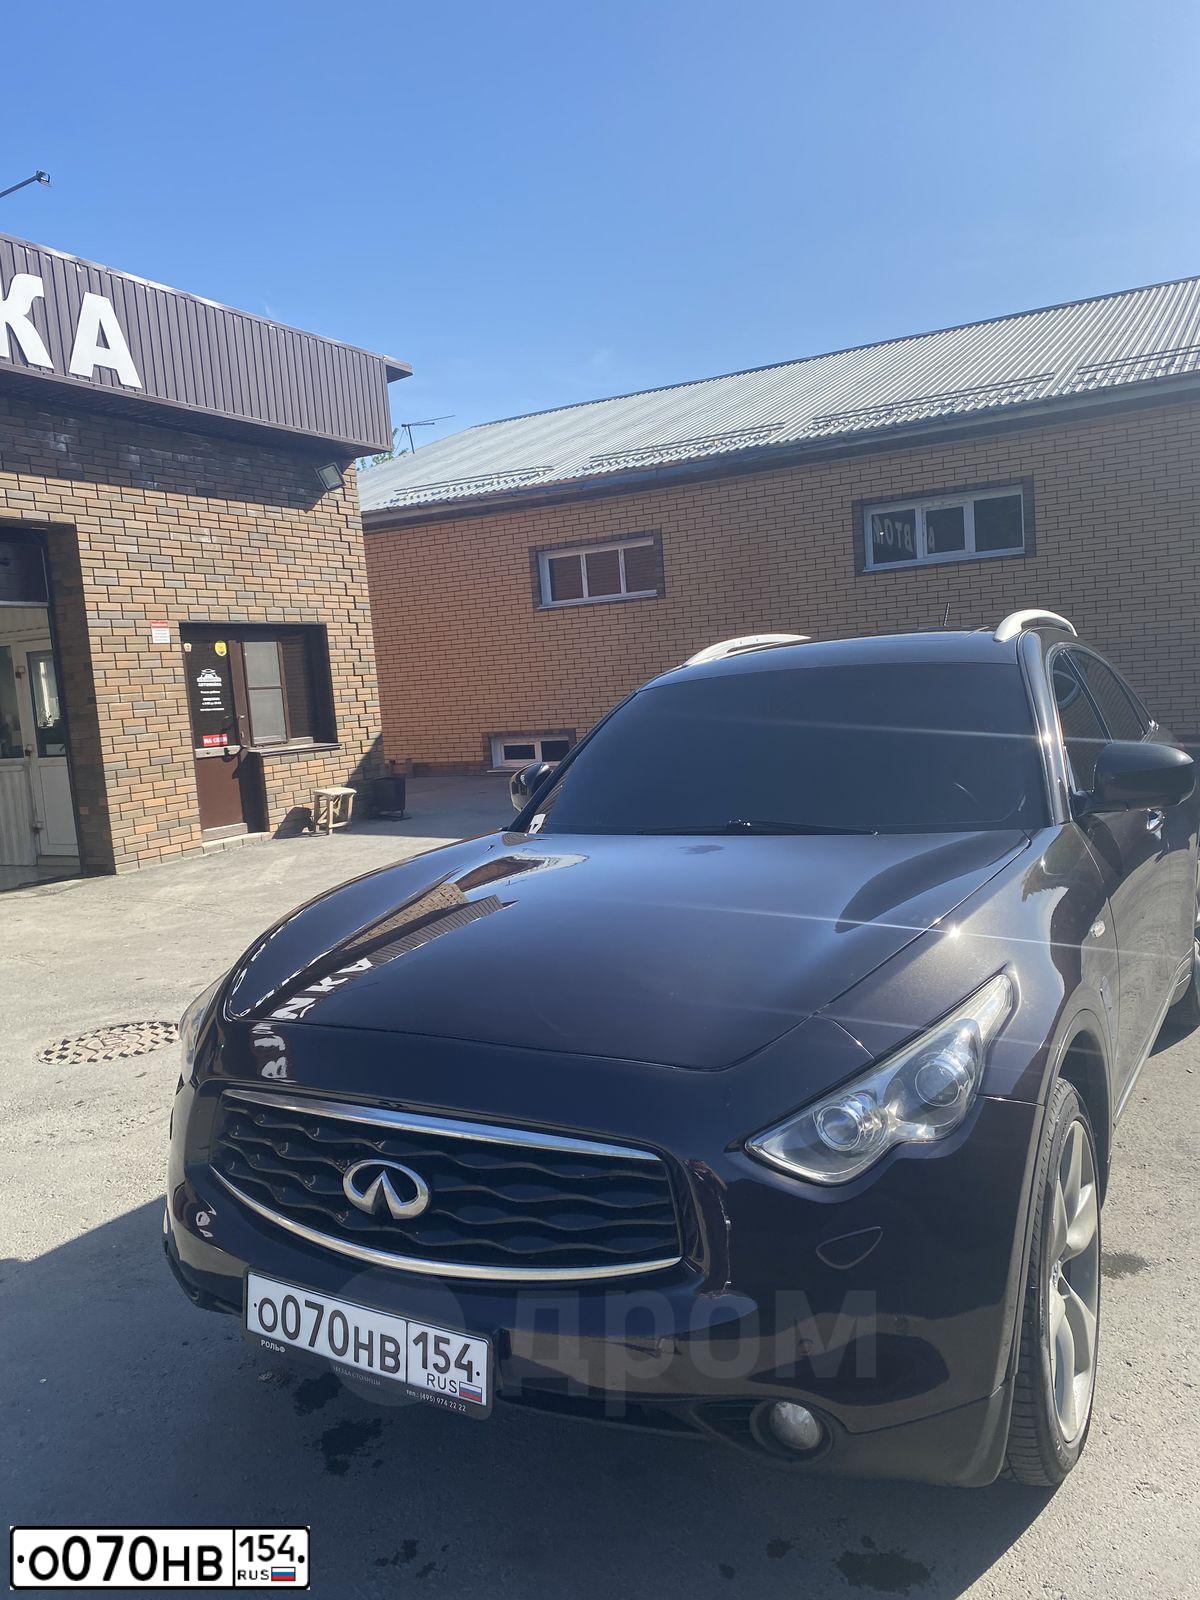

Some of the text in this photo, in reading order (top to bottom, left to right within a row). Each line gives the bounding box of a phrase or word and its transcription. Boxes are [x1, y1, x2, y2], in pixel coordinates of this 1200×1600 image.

[258, 1294, 474, 1383] О070НВ 154
[260, 1339, 286, 1353] РОЛЬФ
[426, 1373, 458, 1394] RUS
